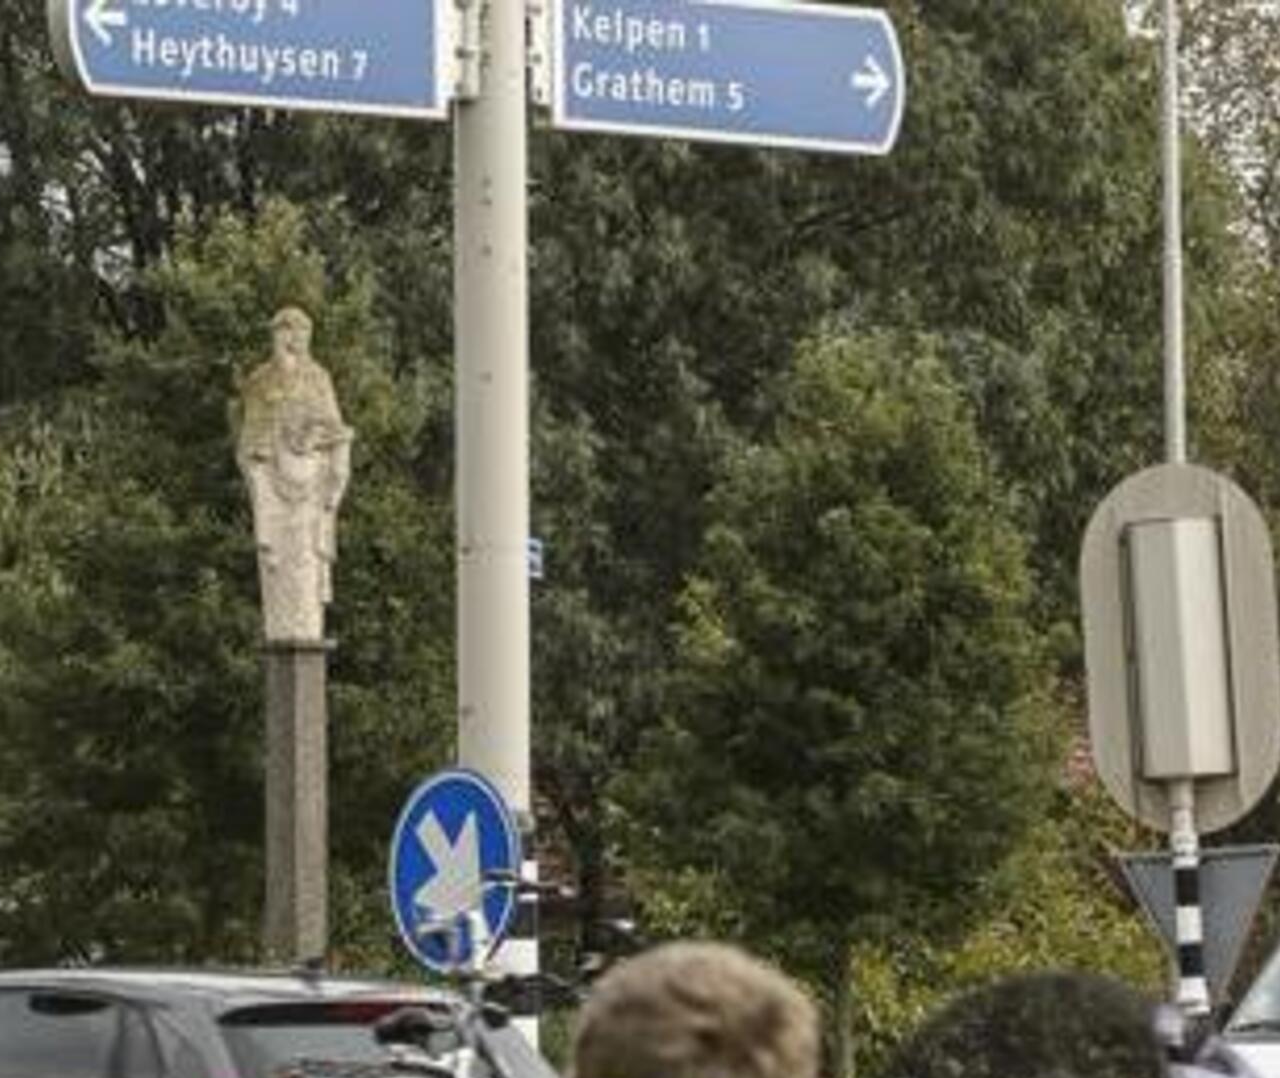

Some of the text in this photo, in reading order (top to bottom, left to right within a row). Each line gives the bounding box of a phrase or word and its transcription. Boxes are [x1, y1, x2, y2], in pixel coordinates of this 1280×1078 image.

[573, 4, 710, 50] Kelpen 1
[131, 28, 368, 84] Heythuysen 7
[573, 63, 744, 111] Grathem 5
